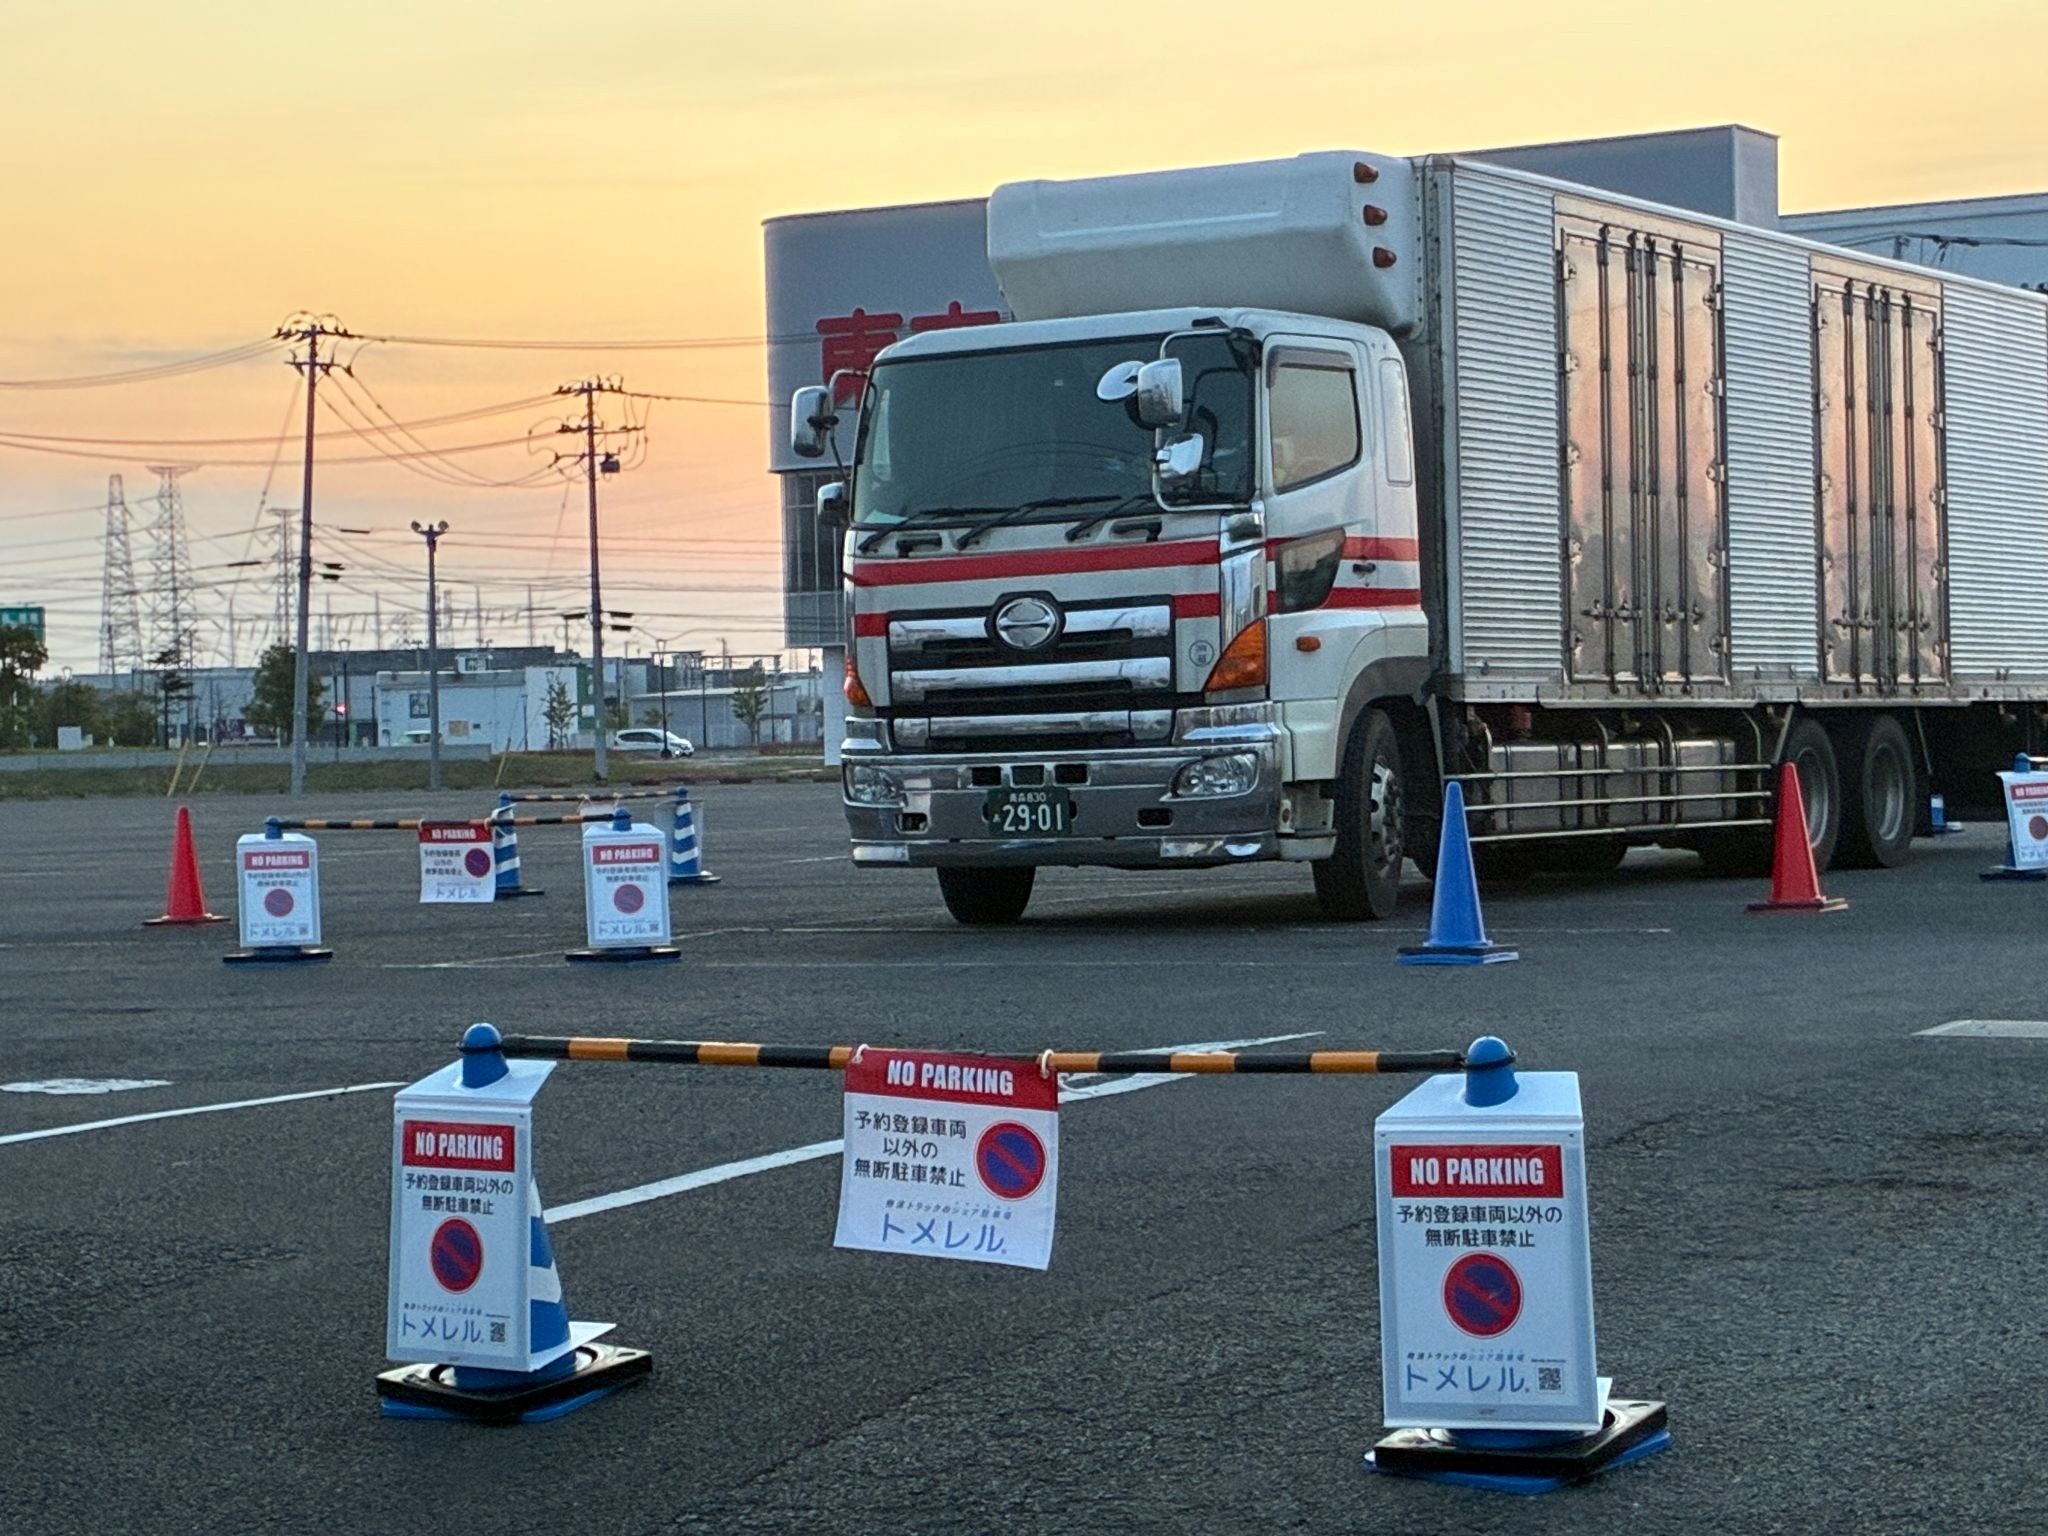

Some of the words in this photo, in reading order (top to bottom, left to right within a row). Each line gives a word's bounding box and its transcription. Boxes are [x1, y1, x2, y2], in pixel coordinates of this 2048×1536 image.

[443, 829, 476, 839] PARKING
[252, 856, 264, 866] NO
[266, 856, 303, 866] PARKING
[600, 850, 612, 861] NO
[615, 849, 653, 860] PARKING
[887, 1060, 915, 1087] NO
[921, 1063, 1013, 1096] PARKING
[854, 1110, 967, 1139] 予約登録車両
[415, 1132, 434, 1156] NO
[438, 1133, 504, 1161] PARKING
[882, 1138, 938, 1159] 以外の
[854, 1158, 967, 1188] 無断駐車禁止
[1410, 1158, 1439, 1185] NO
[1446, 1158, 1544, 1185] PARKING
[405, 1173, 514, 1195] 予約登録車両以外の
[421, 1195, 495, 1216] 無断駐車禁止
[1396, 1205, 1563, 1225] 予約登録車両以外の
[882, 1213, 1005, 1252] トメレル
[1425, 1229, 1535, 1248] 無断駐車禁止
[402, 1313, 482, 1344] トメレル
[1407, 1365, 1525, 1392] トメレル
